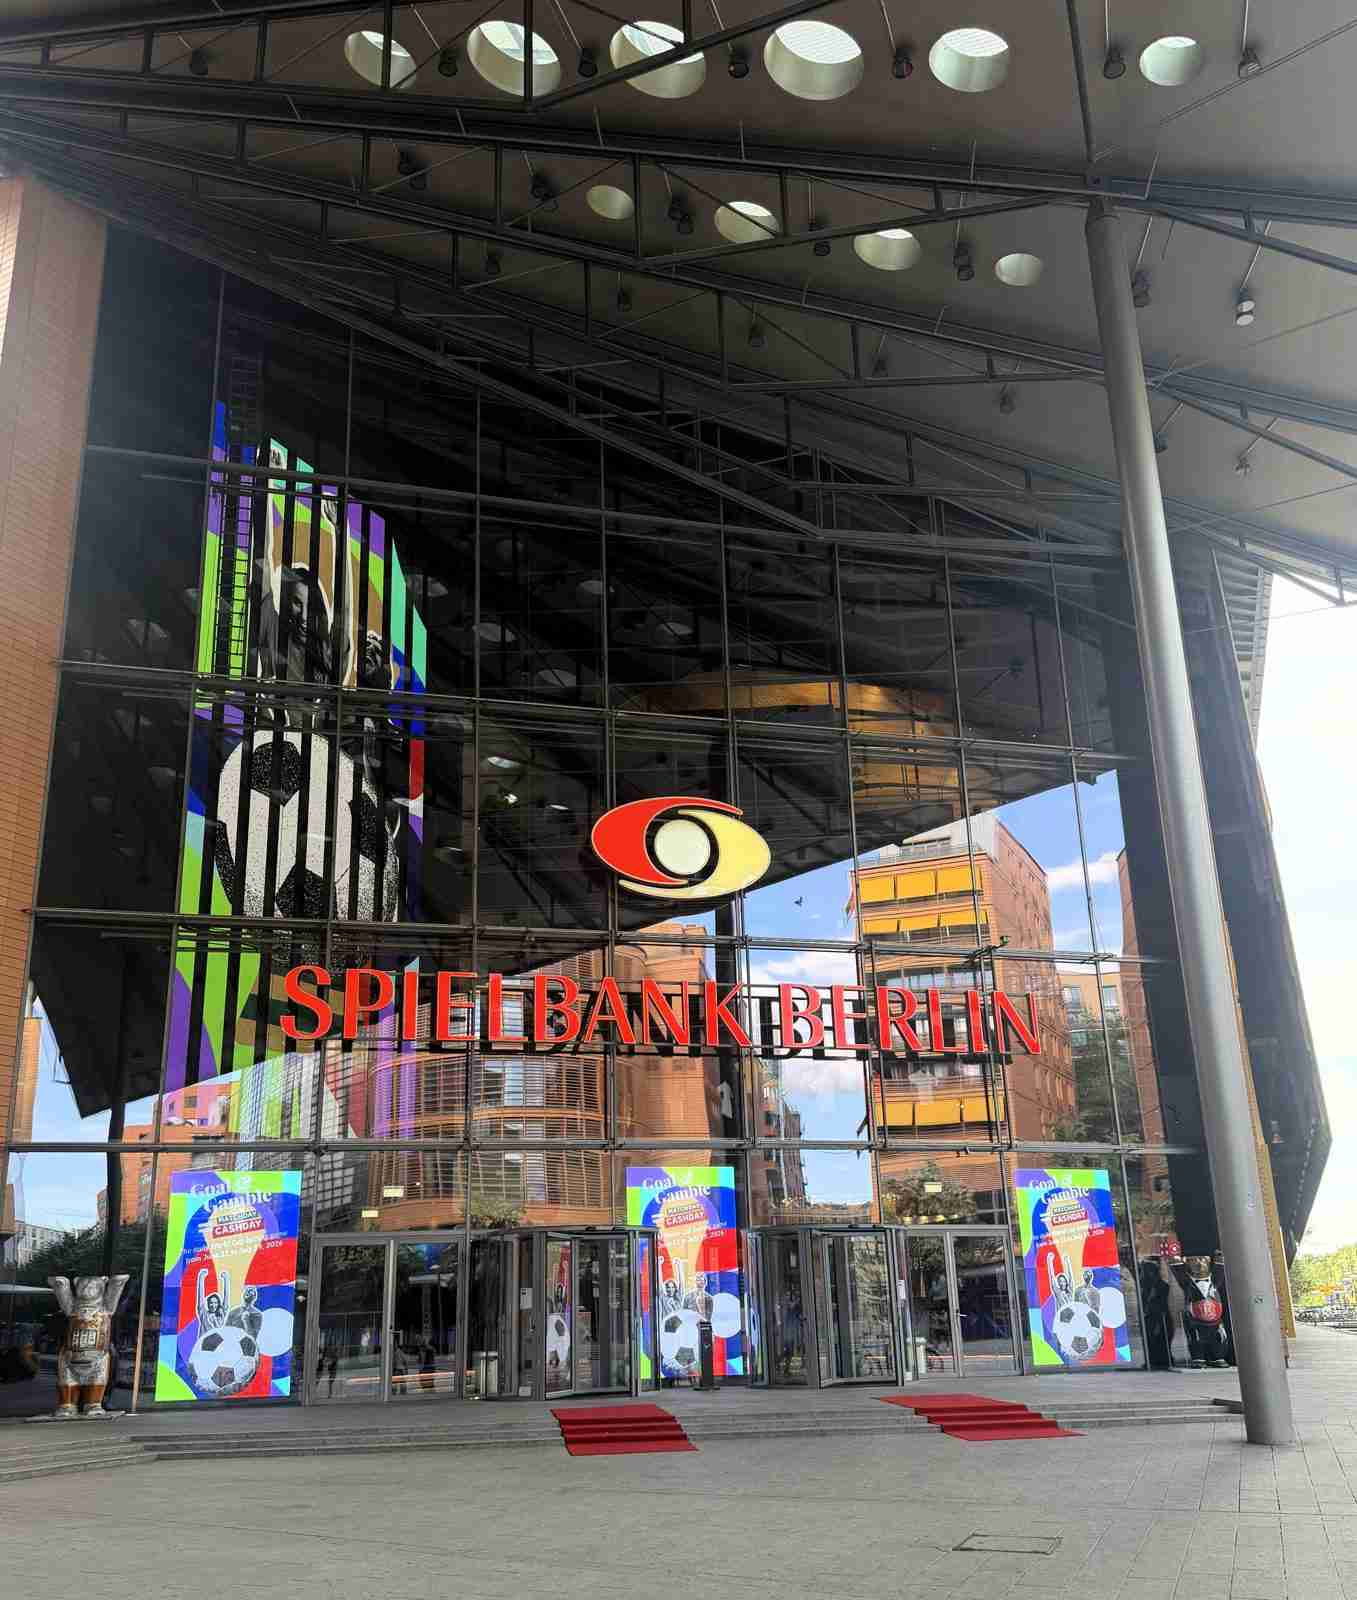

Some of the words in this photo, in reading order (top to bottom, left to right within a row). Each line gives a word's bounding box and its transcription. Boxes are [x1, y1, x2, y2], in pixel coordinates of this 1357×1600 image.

[279, 964, 753, 1048] SPIELBANK
[777, 983, 1042, 1055] BERLIN
[665, 1212, 705, 1226] CASHDAY
[1052, 1210, 1086, 1224] CASHDAY
[215, 1220, 262, 1235] CASHDAY
